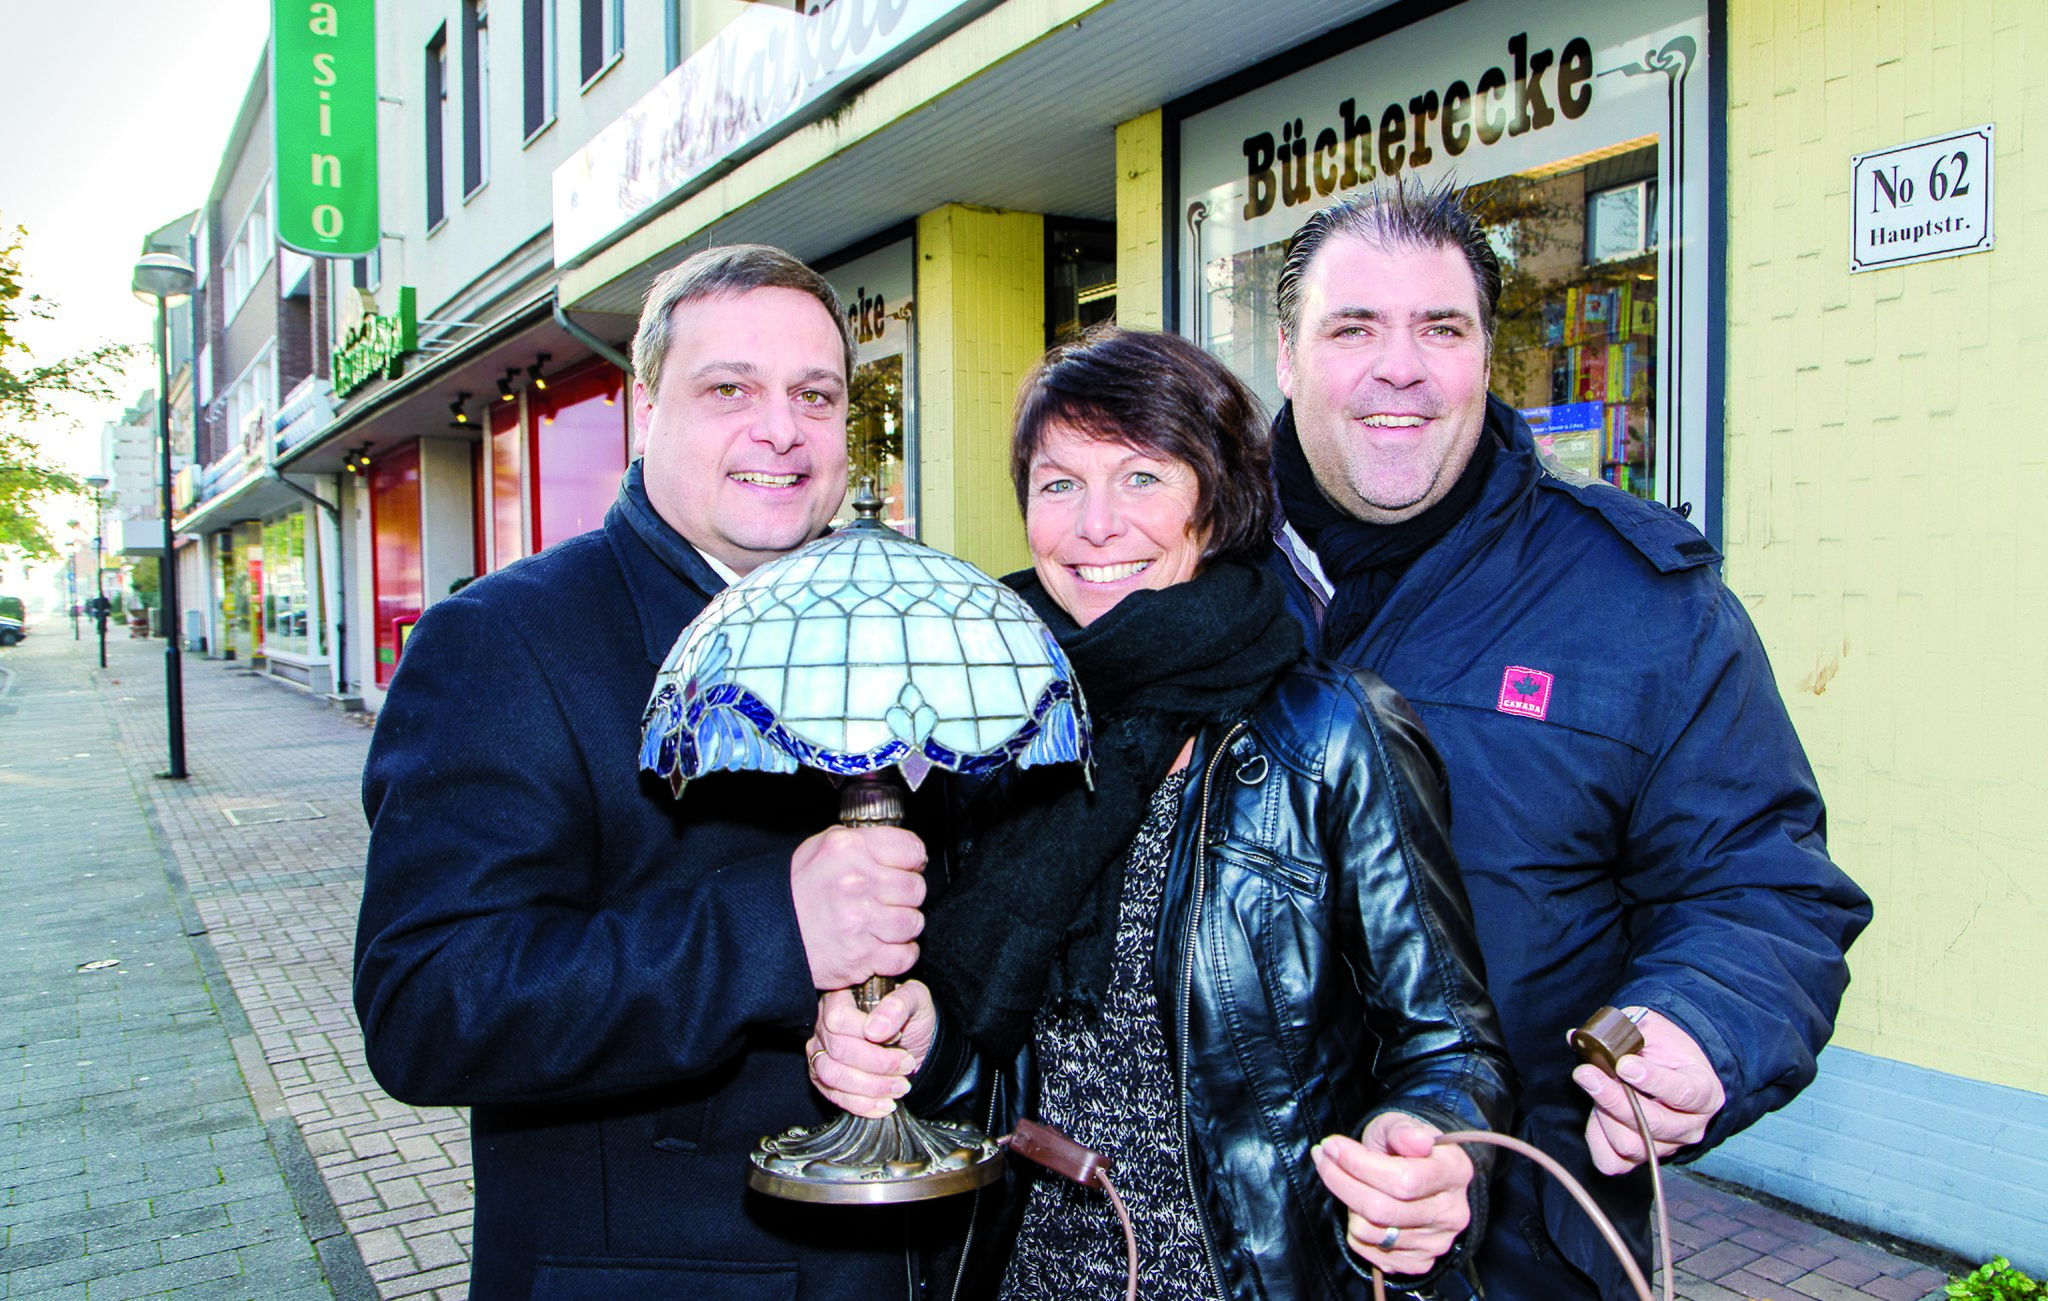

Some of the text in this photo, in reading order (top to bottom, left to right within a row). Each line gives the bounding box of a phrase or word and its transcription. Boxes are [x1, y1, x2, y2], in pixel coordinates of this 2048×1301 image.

[1242, 32, 1593, 221] Bücherecke
[1870, 151, 1970, 213] No 62
[1870, 216, 1970, 247] Hauptstr.
[1503, 699, 1541, 713] CANADA
